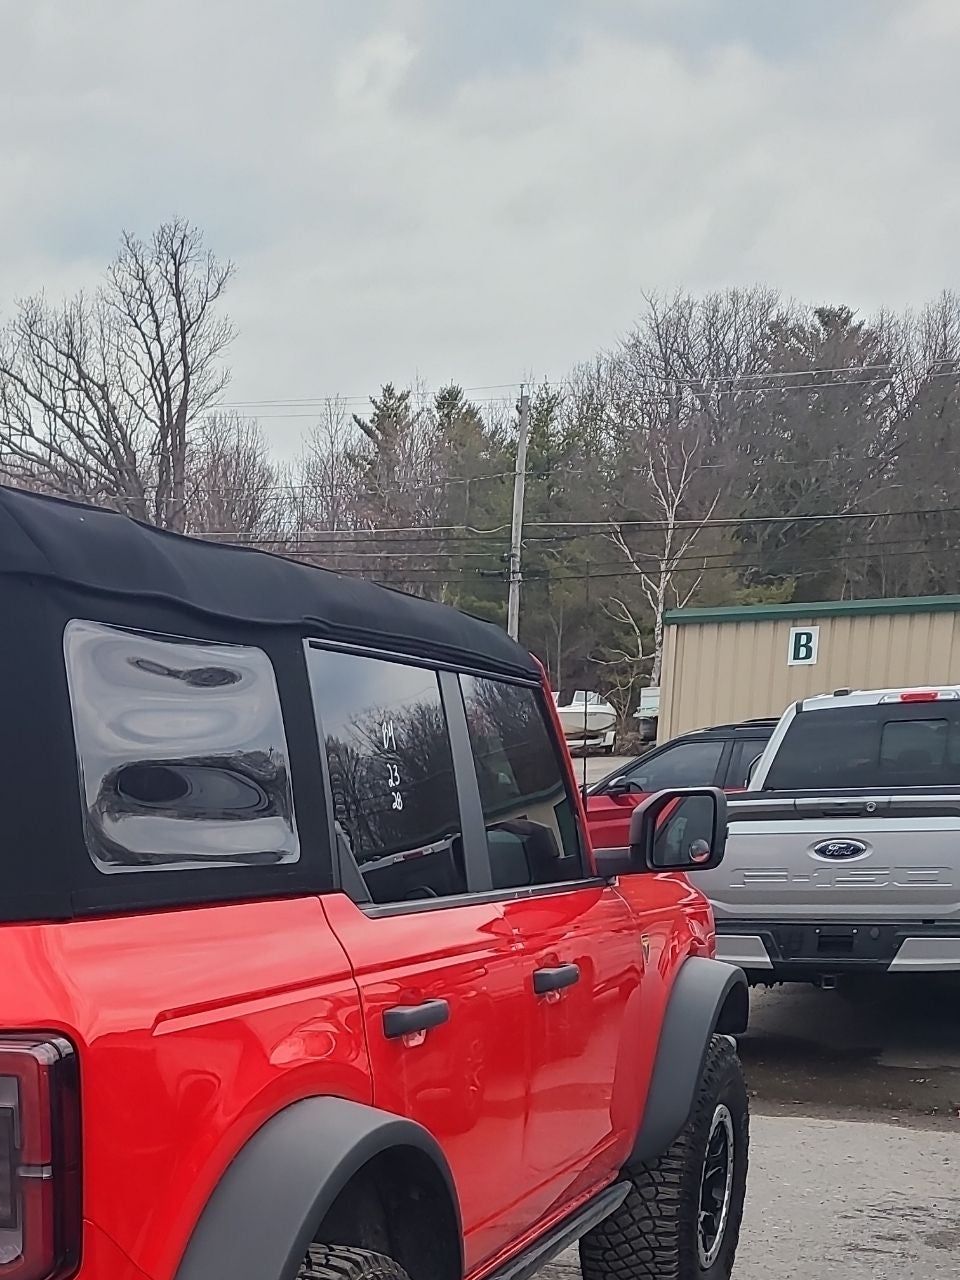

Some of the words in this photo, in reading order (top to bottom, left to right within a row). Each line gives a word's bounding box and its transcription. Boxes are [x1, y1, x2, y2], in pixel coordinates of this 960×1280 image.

[793, 632, 813, 660] B
[386, 763, 401, 788] 23
[825, 843, 854, 856] Ford
